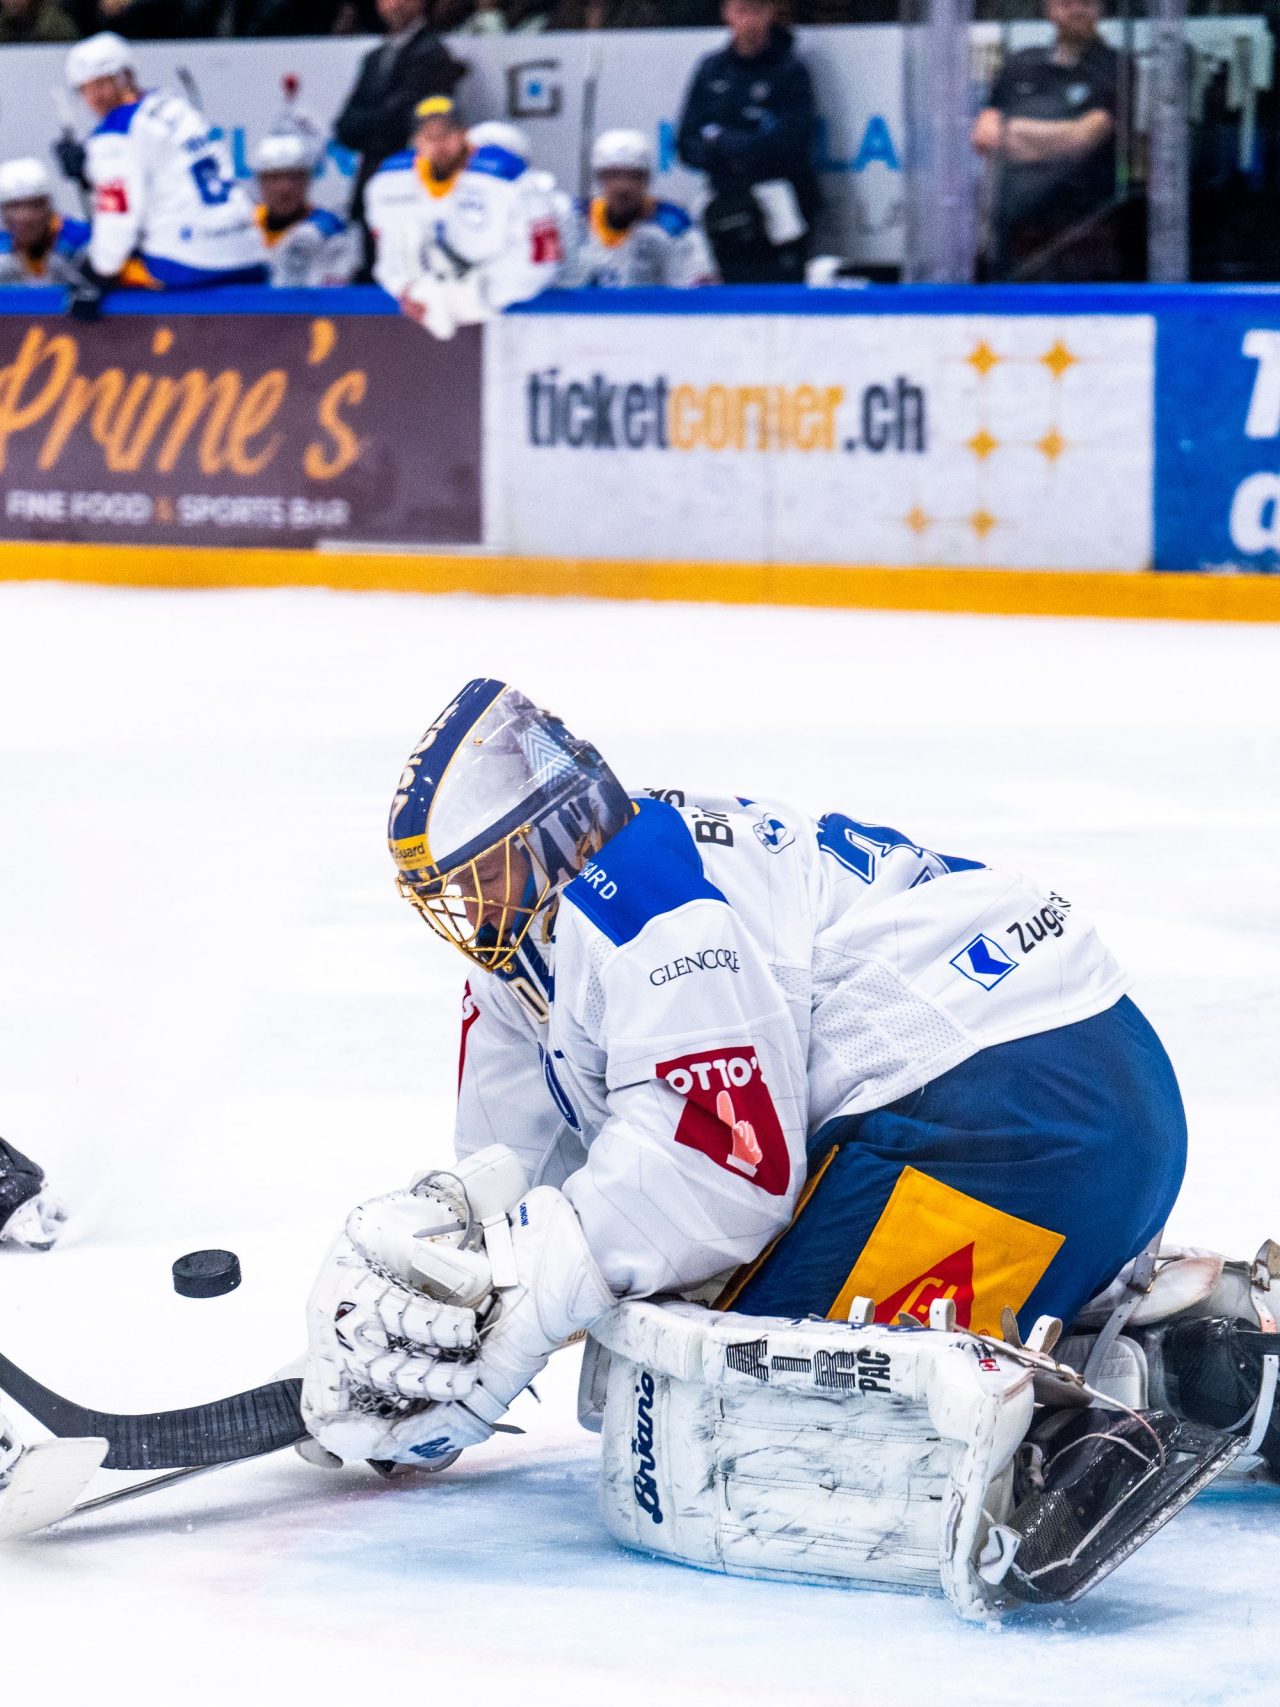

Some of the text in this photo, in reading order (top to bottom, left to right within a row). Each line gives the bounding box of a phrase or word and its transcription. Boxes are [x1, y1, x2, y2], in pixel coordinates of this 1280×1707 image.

[528, 368, 928, 454] ticketcorner.ch
[5, 489, 64, 523] FINE
[71, 491, 153, 525] FOOD
[178, 494, 287, 528] SPORTS
[290, 497, 350, 530] BAR
[650, 948, 740, 986] GLENCORE
[665, 1056, 765, 1095] OTTO'
[857, 1349, 891, 1393] PAC
